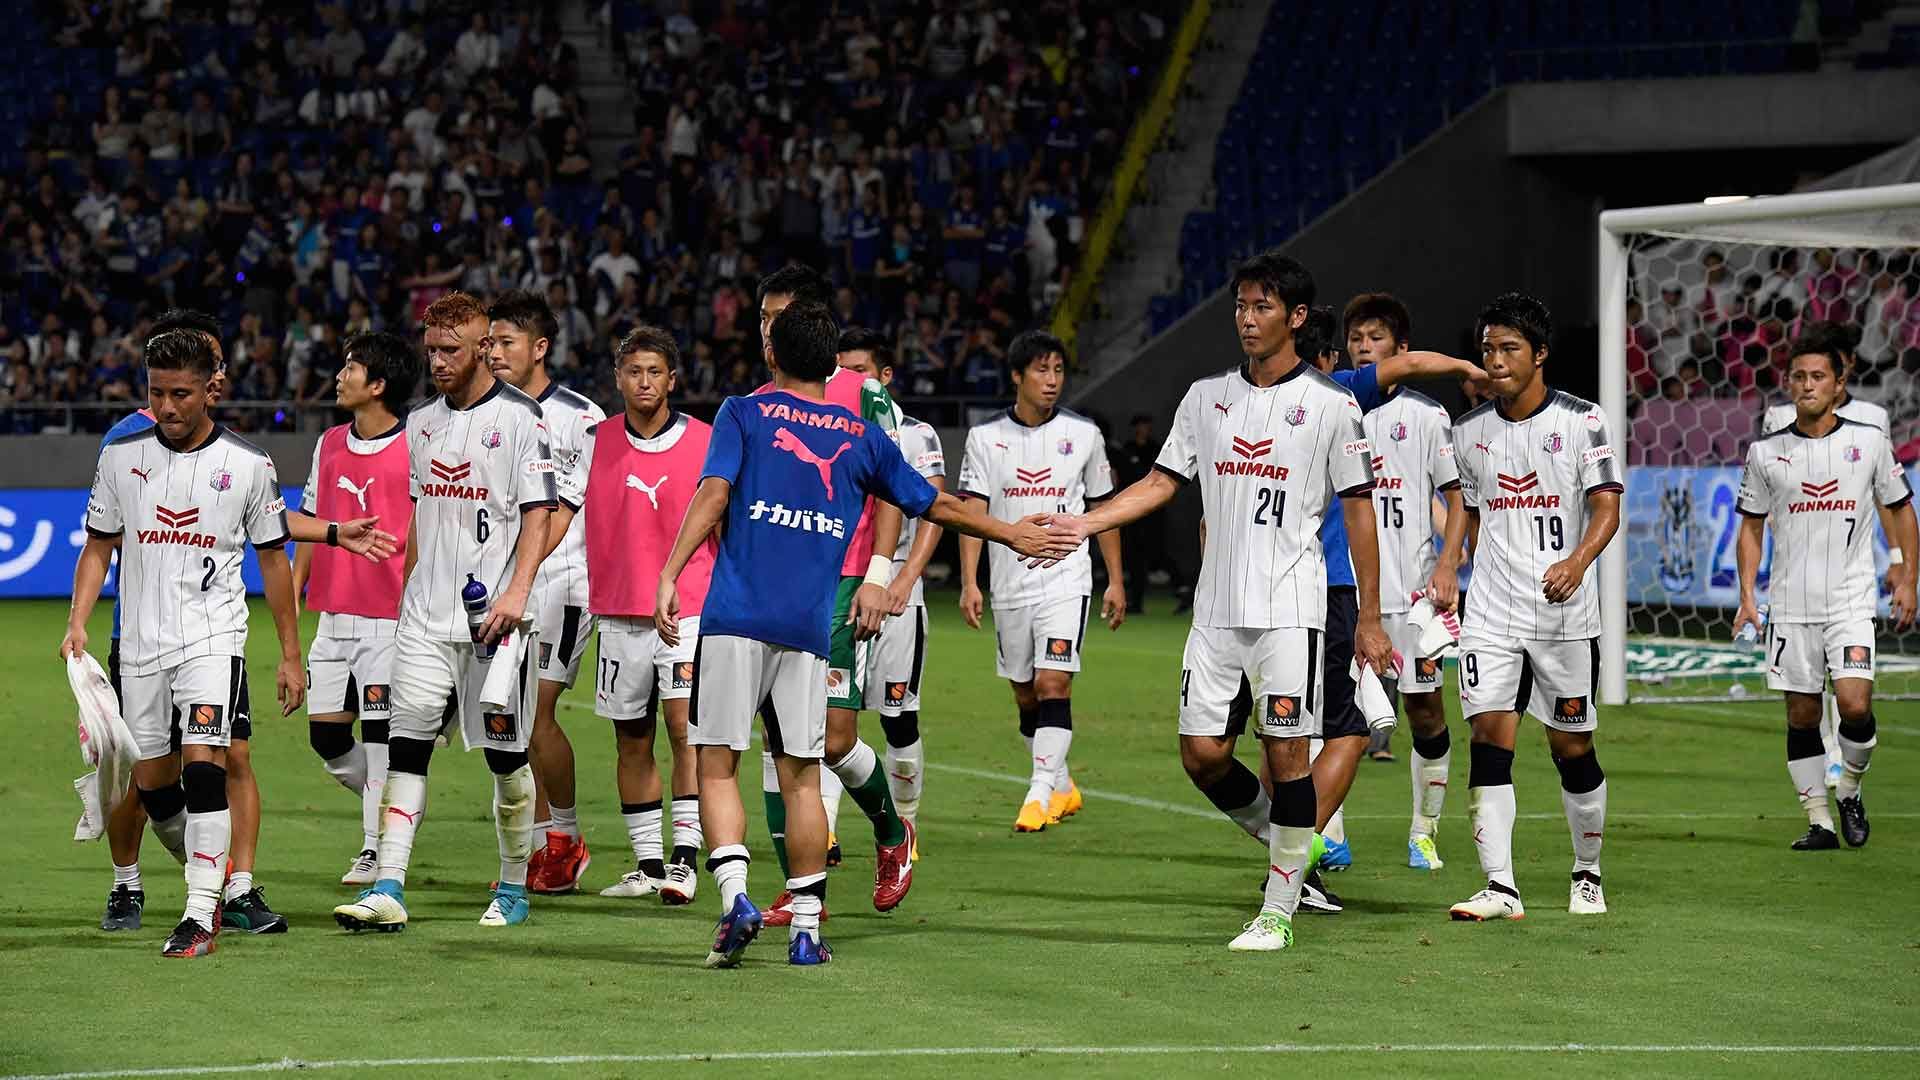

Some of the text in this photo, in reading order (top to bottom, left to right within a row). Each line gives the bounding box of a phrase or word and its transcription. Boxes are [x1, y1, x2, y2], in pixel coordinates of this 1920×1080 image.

[758, 402, 865, 437] YANMAR
[1214, 461, 1289, 481] YANMAR
[1003, 487, 1067, 498] YANMAR
[1254, 487, 1286, 528] 24
[1486, 495, 1560, 511] YANMAR
[1788, 500, 1856, 514] YANMAR
[477, 508, 490, 544] 6
[750, 500, 845, 539] ナカバヤシ
[1380, 496, 1404, 528] 15
[137, 530, 216, 549] YANMAR
[1534, 515, 1564, 551] 19
[1845, 518, 1855, 549] 7
[200, 556, 216, 592] 2
[1776, 637, 1786, 667] 7
[601, 657, 620, 694] 17
[1459, 653, 1479, 691] 19
[188, 725, 221, 735] SANYU
[1267, 716, 1299, 726] SANYU
[1555, 714, 1586, 723] SANYU
[486, 732, 516, 741] SANYU
